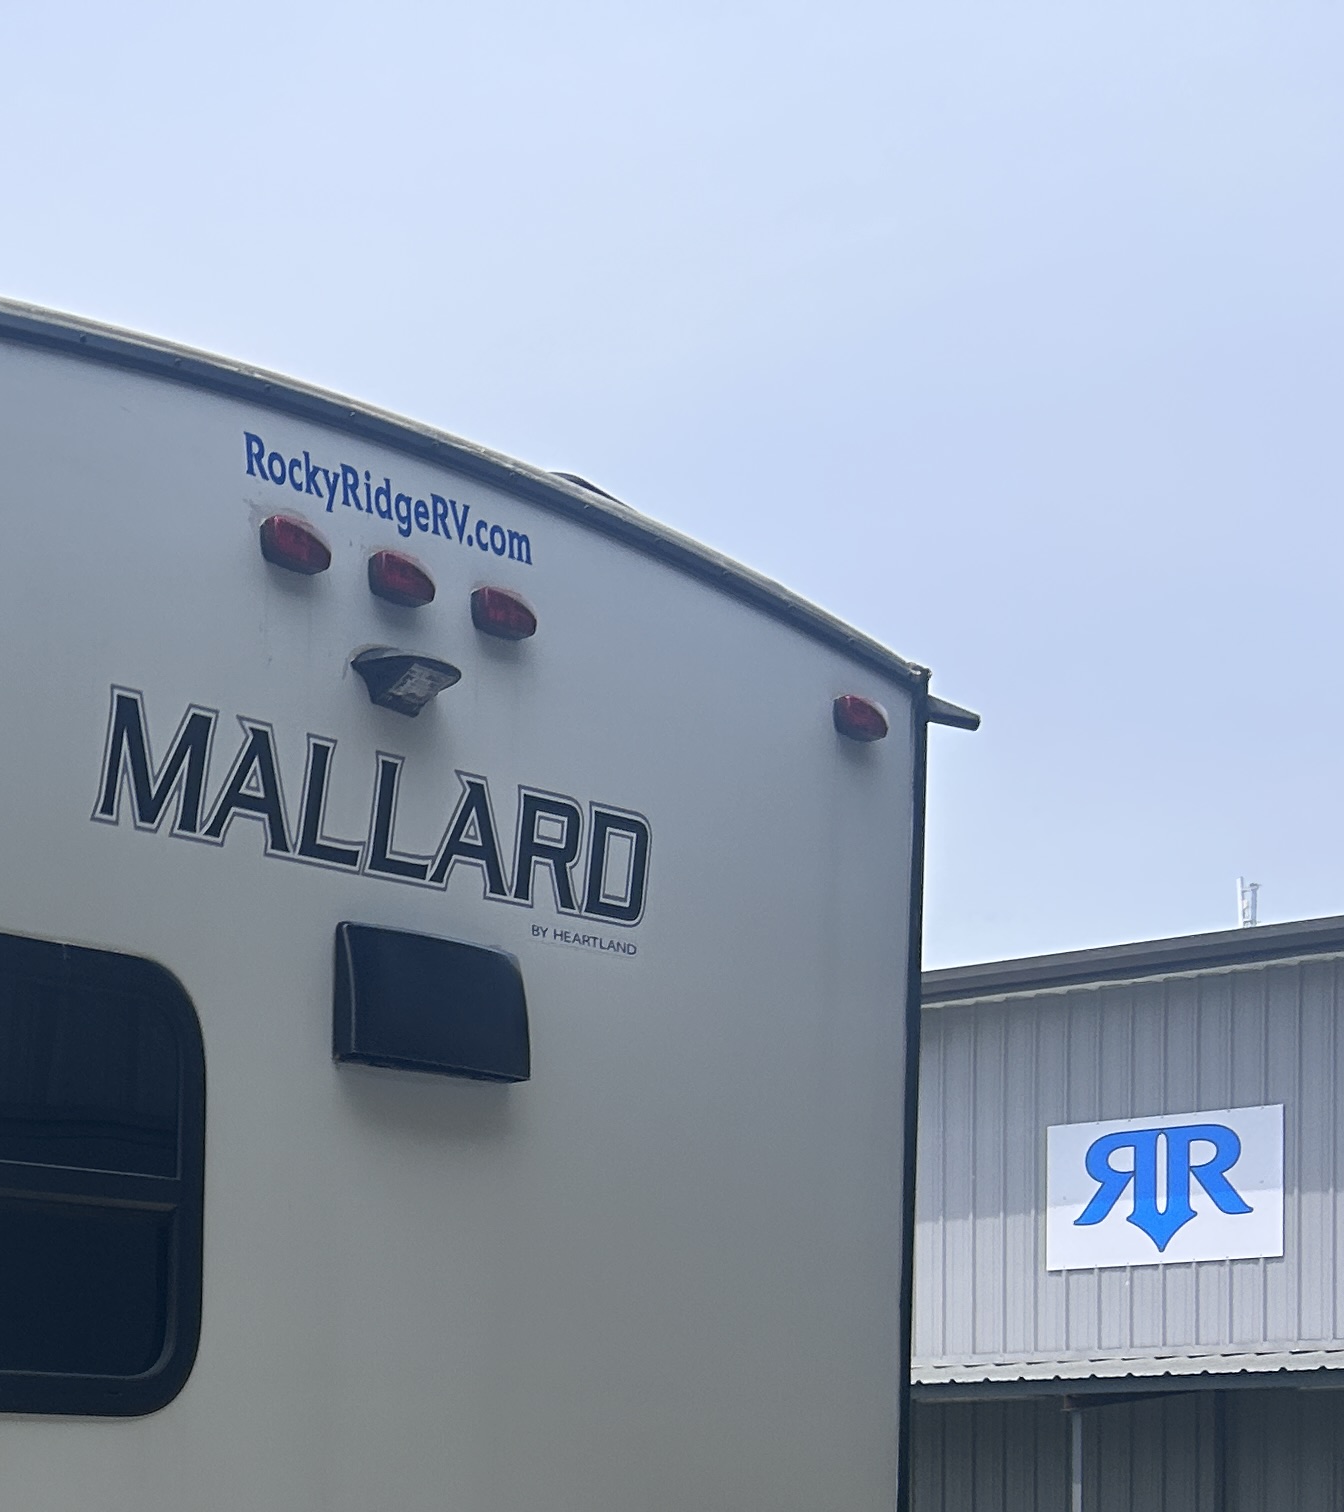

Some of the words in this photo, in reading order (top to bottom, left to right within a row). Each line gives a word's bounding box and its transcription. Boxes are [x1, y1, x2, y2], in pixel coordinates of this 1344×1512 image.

[243, 431, 533, 566] RockyRidgeRV.com
[91, 683, 653, 927] MALLARD
[531, 923, 549, 939] BY
[552, 927, 637, 956] HEARTLAND
